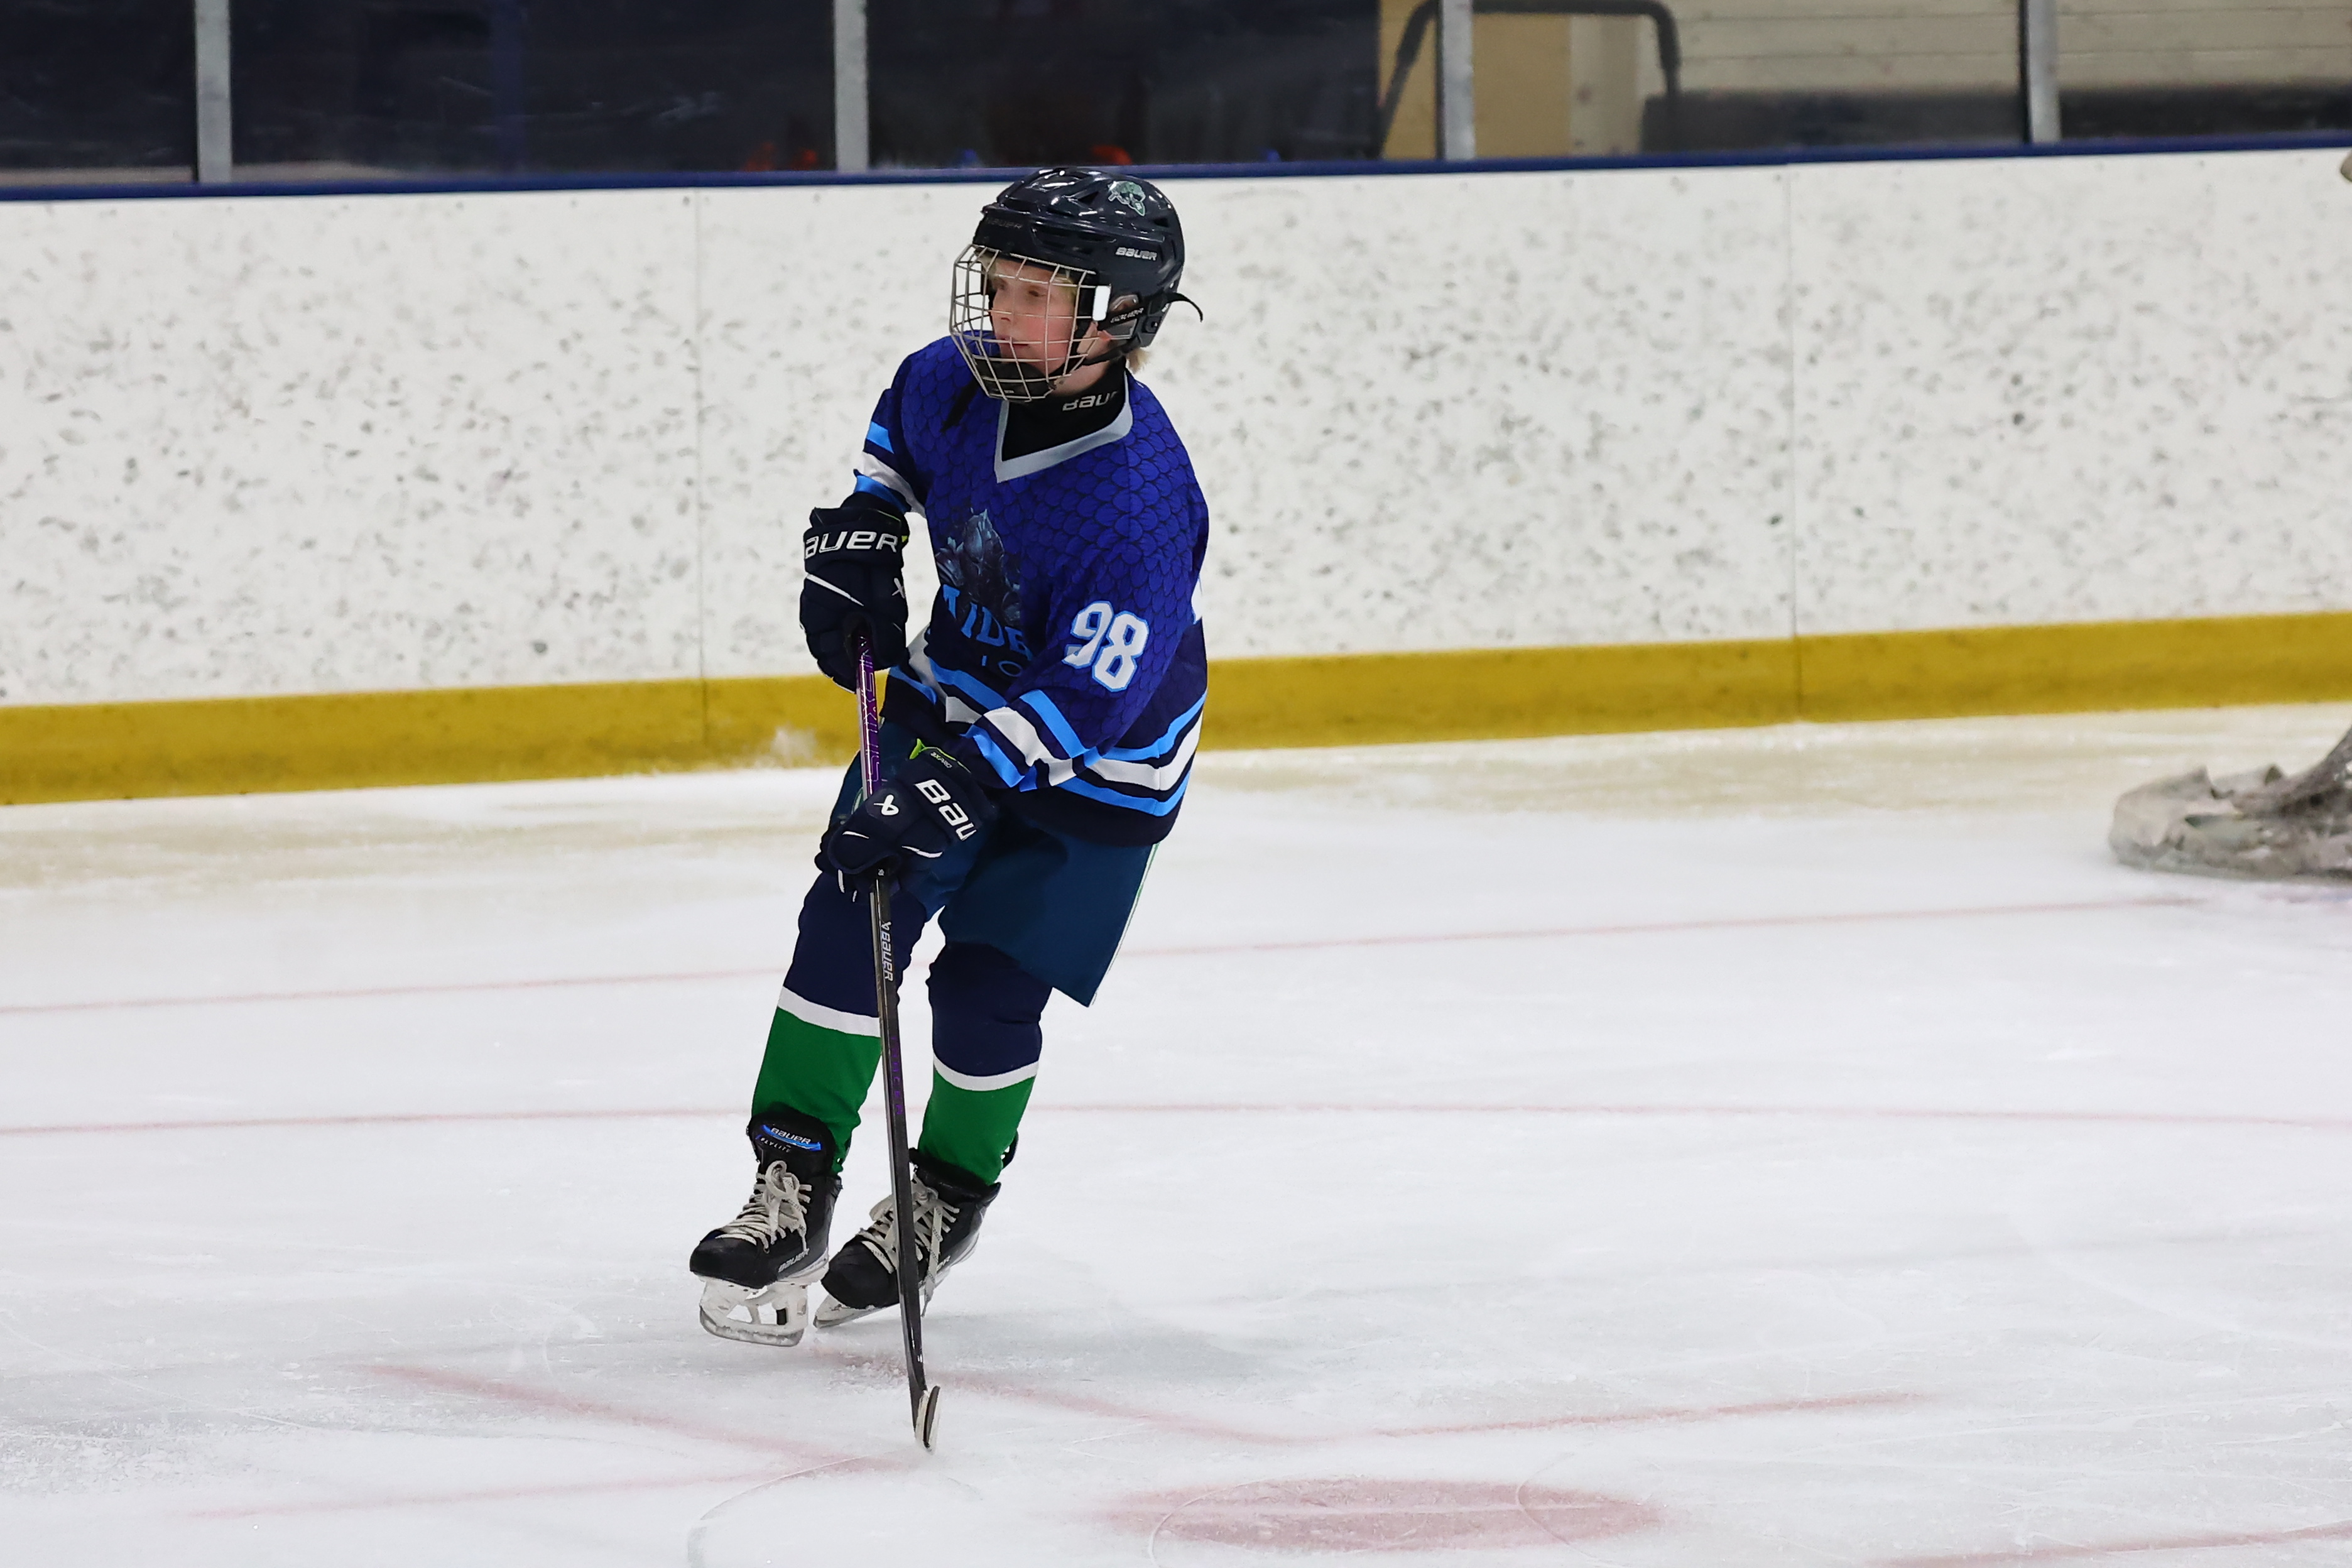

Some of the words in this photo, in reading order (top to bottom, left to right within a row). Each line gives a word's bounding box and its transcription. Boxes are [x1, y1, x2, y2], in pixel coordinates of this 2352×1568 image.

[985, 216, 1023, 229] AUER
[1116, 247, 1157, 261] BAUER
[1062, 391, 1118, 411] BAU
[805, 531, 898, 560] AUER
[1062, 601, 1150, 692] 98
[881, 930, 893, 982] BAUER
[771, 1128, 812, 1145] BAUER
